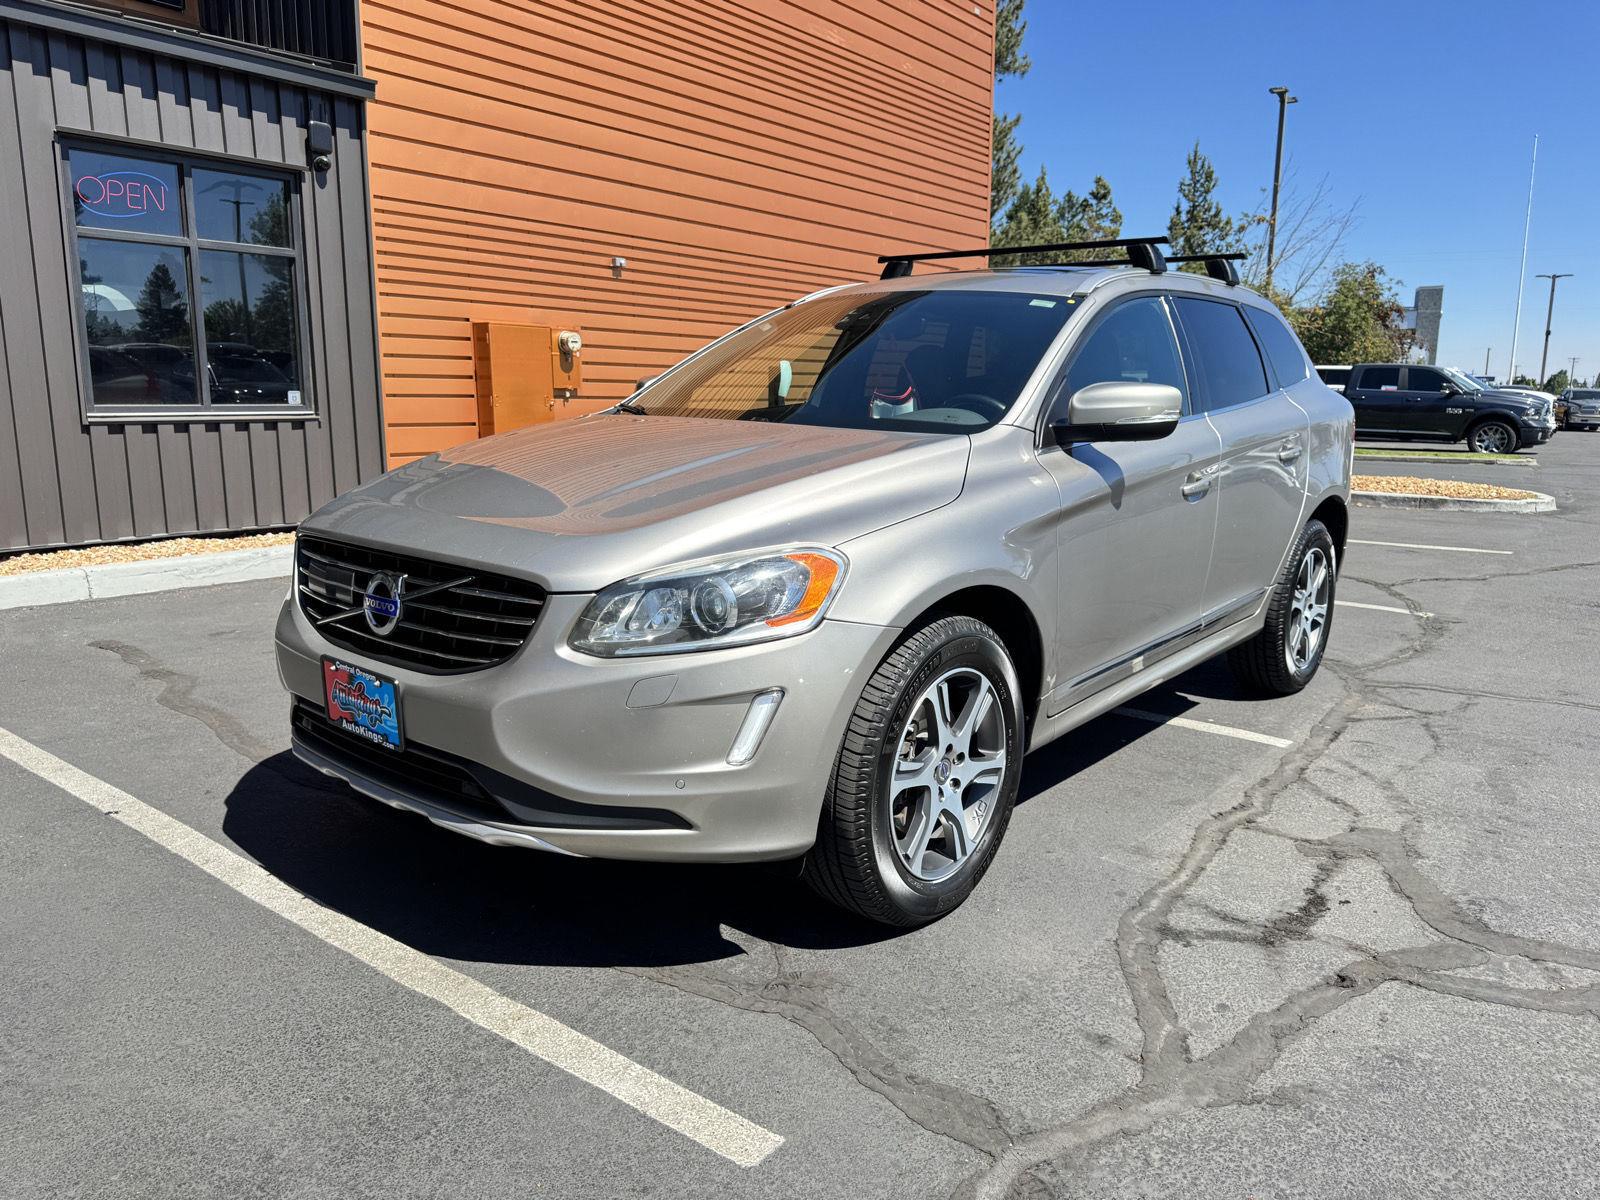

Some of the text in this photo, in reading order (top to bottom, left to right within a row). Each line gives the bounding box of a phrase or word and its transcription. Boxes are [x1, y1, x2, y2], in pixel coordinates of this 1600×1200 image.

[76, 175, 165, 211] OPEN
[365, 597, 395, 612] VOLVO
[335, 661, 355, 675] Central
